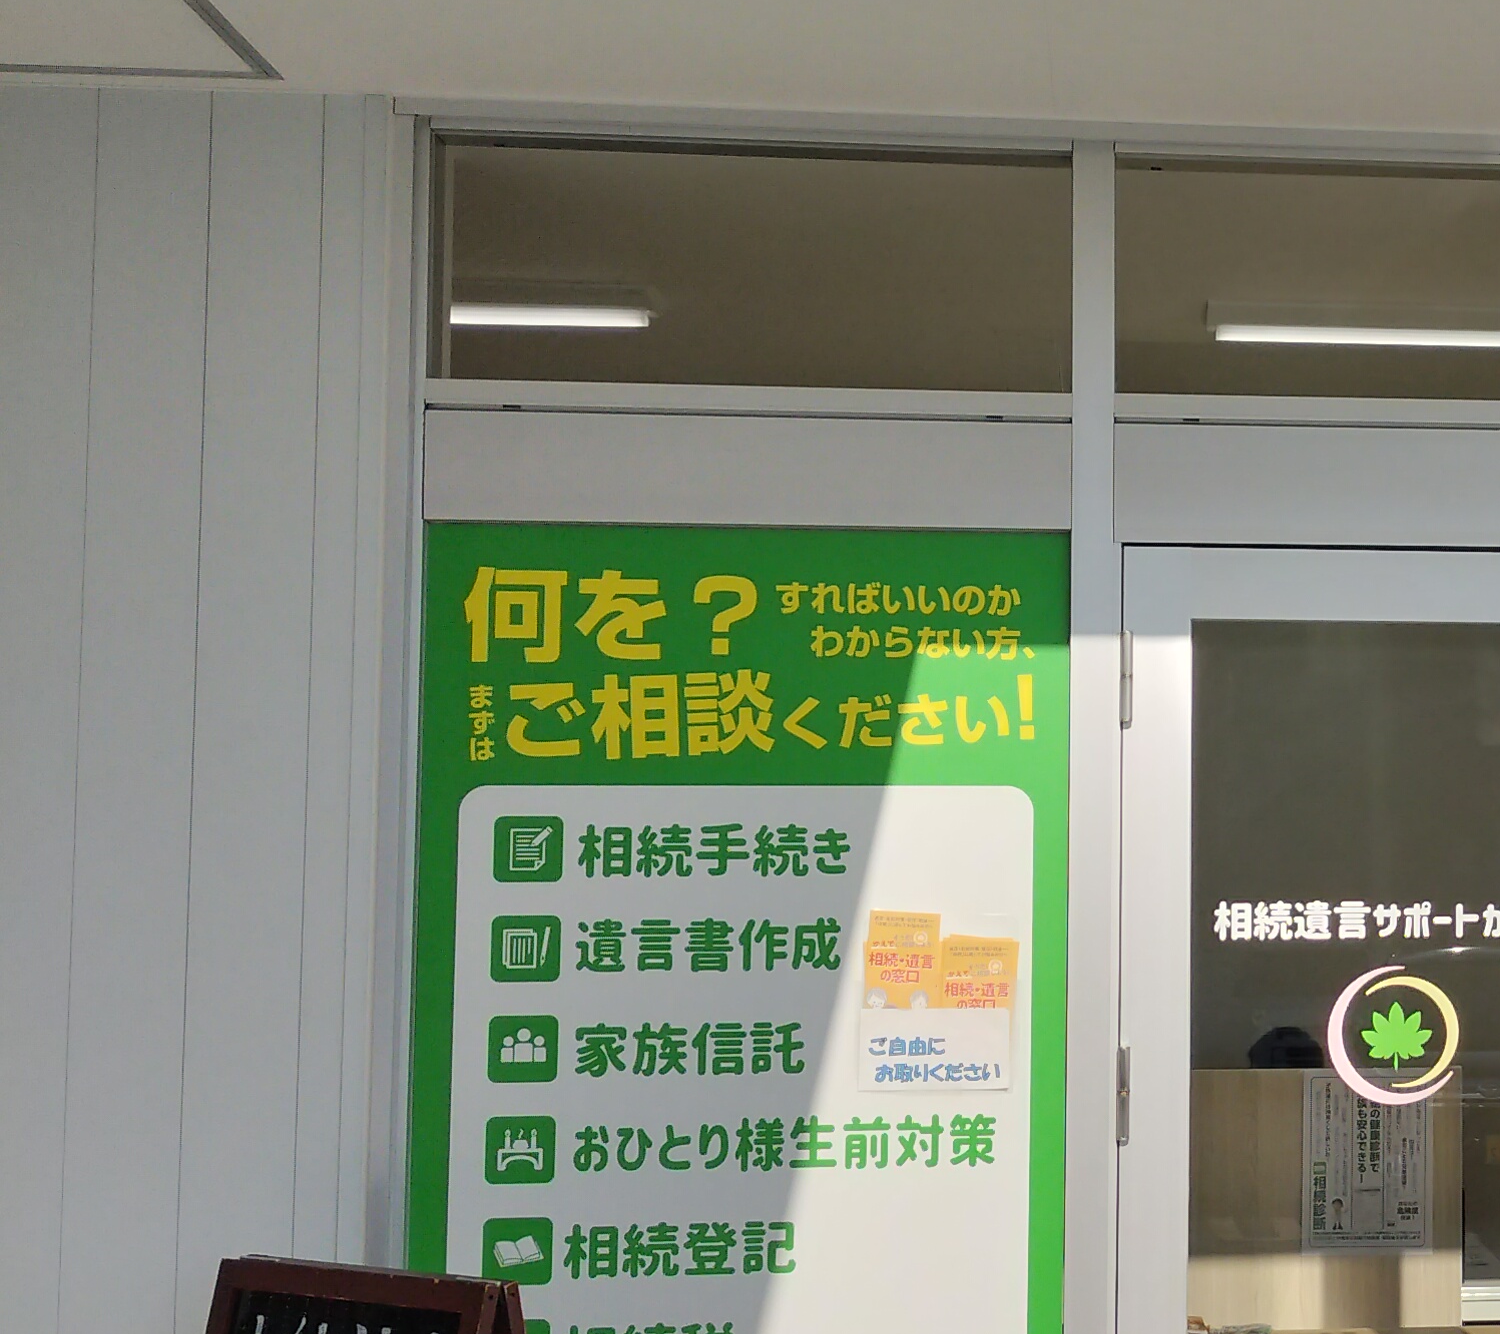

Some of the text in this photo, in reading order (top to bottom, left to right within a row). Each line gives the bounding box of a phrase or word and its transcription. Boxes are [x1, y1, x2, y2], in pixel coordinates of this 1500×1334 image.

[776, 582, 1021, 616] すればいいのか
[810, 625, 1035, 661] わからない方、
[469, 684, 495, 762] まずは
[577, 823, 851, 878] 相続手続き
[576, 918, 841, 973] 遺言書作成
[868, 952, 935, 970] 相続・遺言
[879, 969, 920, 984] の窓口
[944, 982, 1010, 998] 相続・遺言
[574, 1022, 805, 1077] 家族信託
[868, 1037, 946, 1056] ご自由に
[874, 1063, 1001, 1083] お取りください
[572, 1113, 997, 1172] おひとり様生前対策
[563, 1221, 797, 1278] 相続登記
